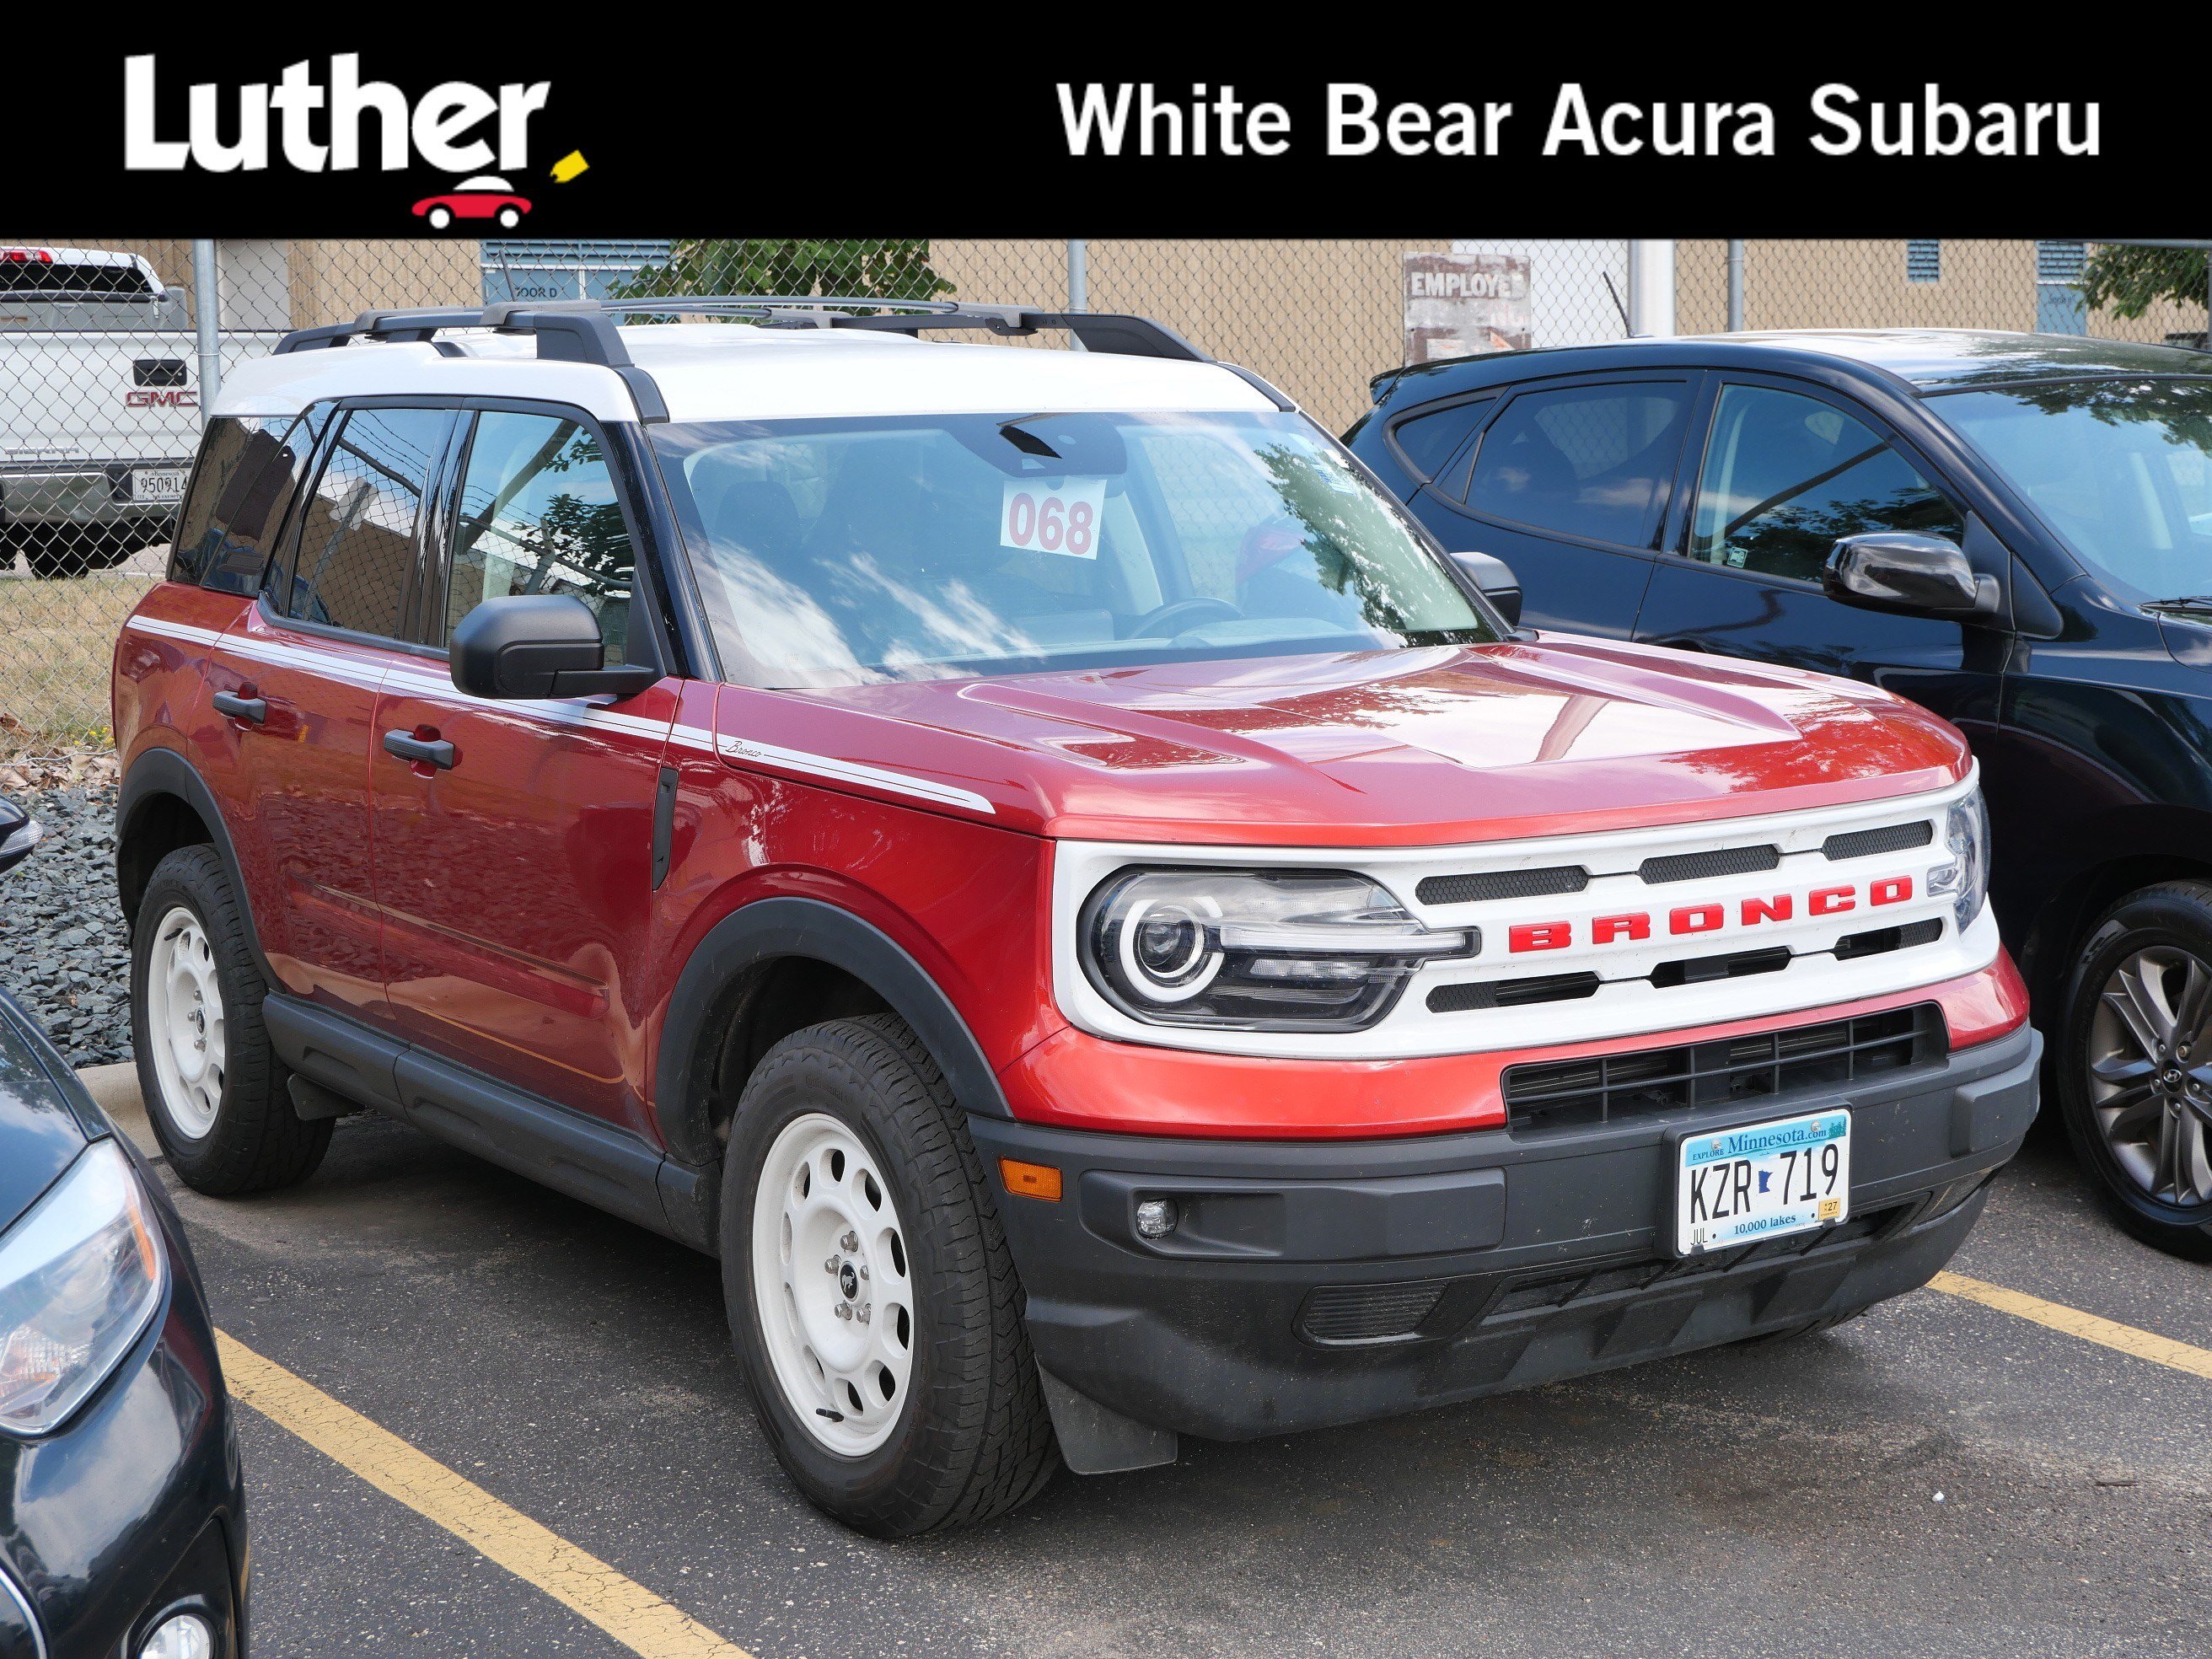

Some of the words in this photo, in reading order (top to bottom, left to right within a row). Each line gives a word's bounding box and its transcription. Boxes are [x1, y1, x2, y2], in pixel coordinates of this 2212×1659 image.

[126, 391, 197, 407] GMC
[141, 476, 187, 493] 950914
[1008, 492, 1094, 556] 068
[725, 740, 762, 758] Bronco
[1508, 874, 1914, 953] BRONCO
[1692, 1148, 1725, 1161] EXPLORE
[1690, 1159, 1752, 1224] KZR
[1780, 1143, 1839, 1205] 719
[1828, 1200, 1838, 1211] 27
[1733, 1219, 1767, 1235] 10,000
[1769, 1214, 1796, 1227] lakes
[1690, 1227, 1708, 1246] JUL
